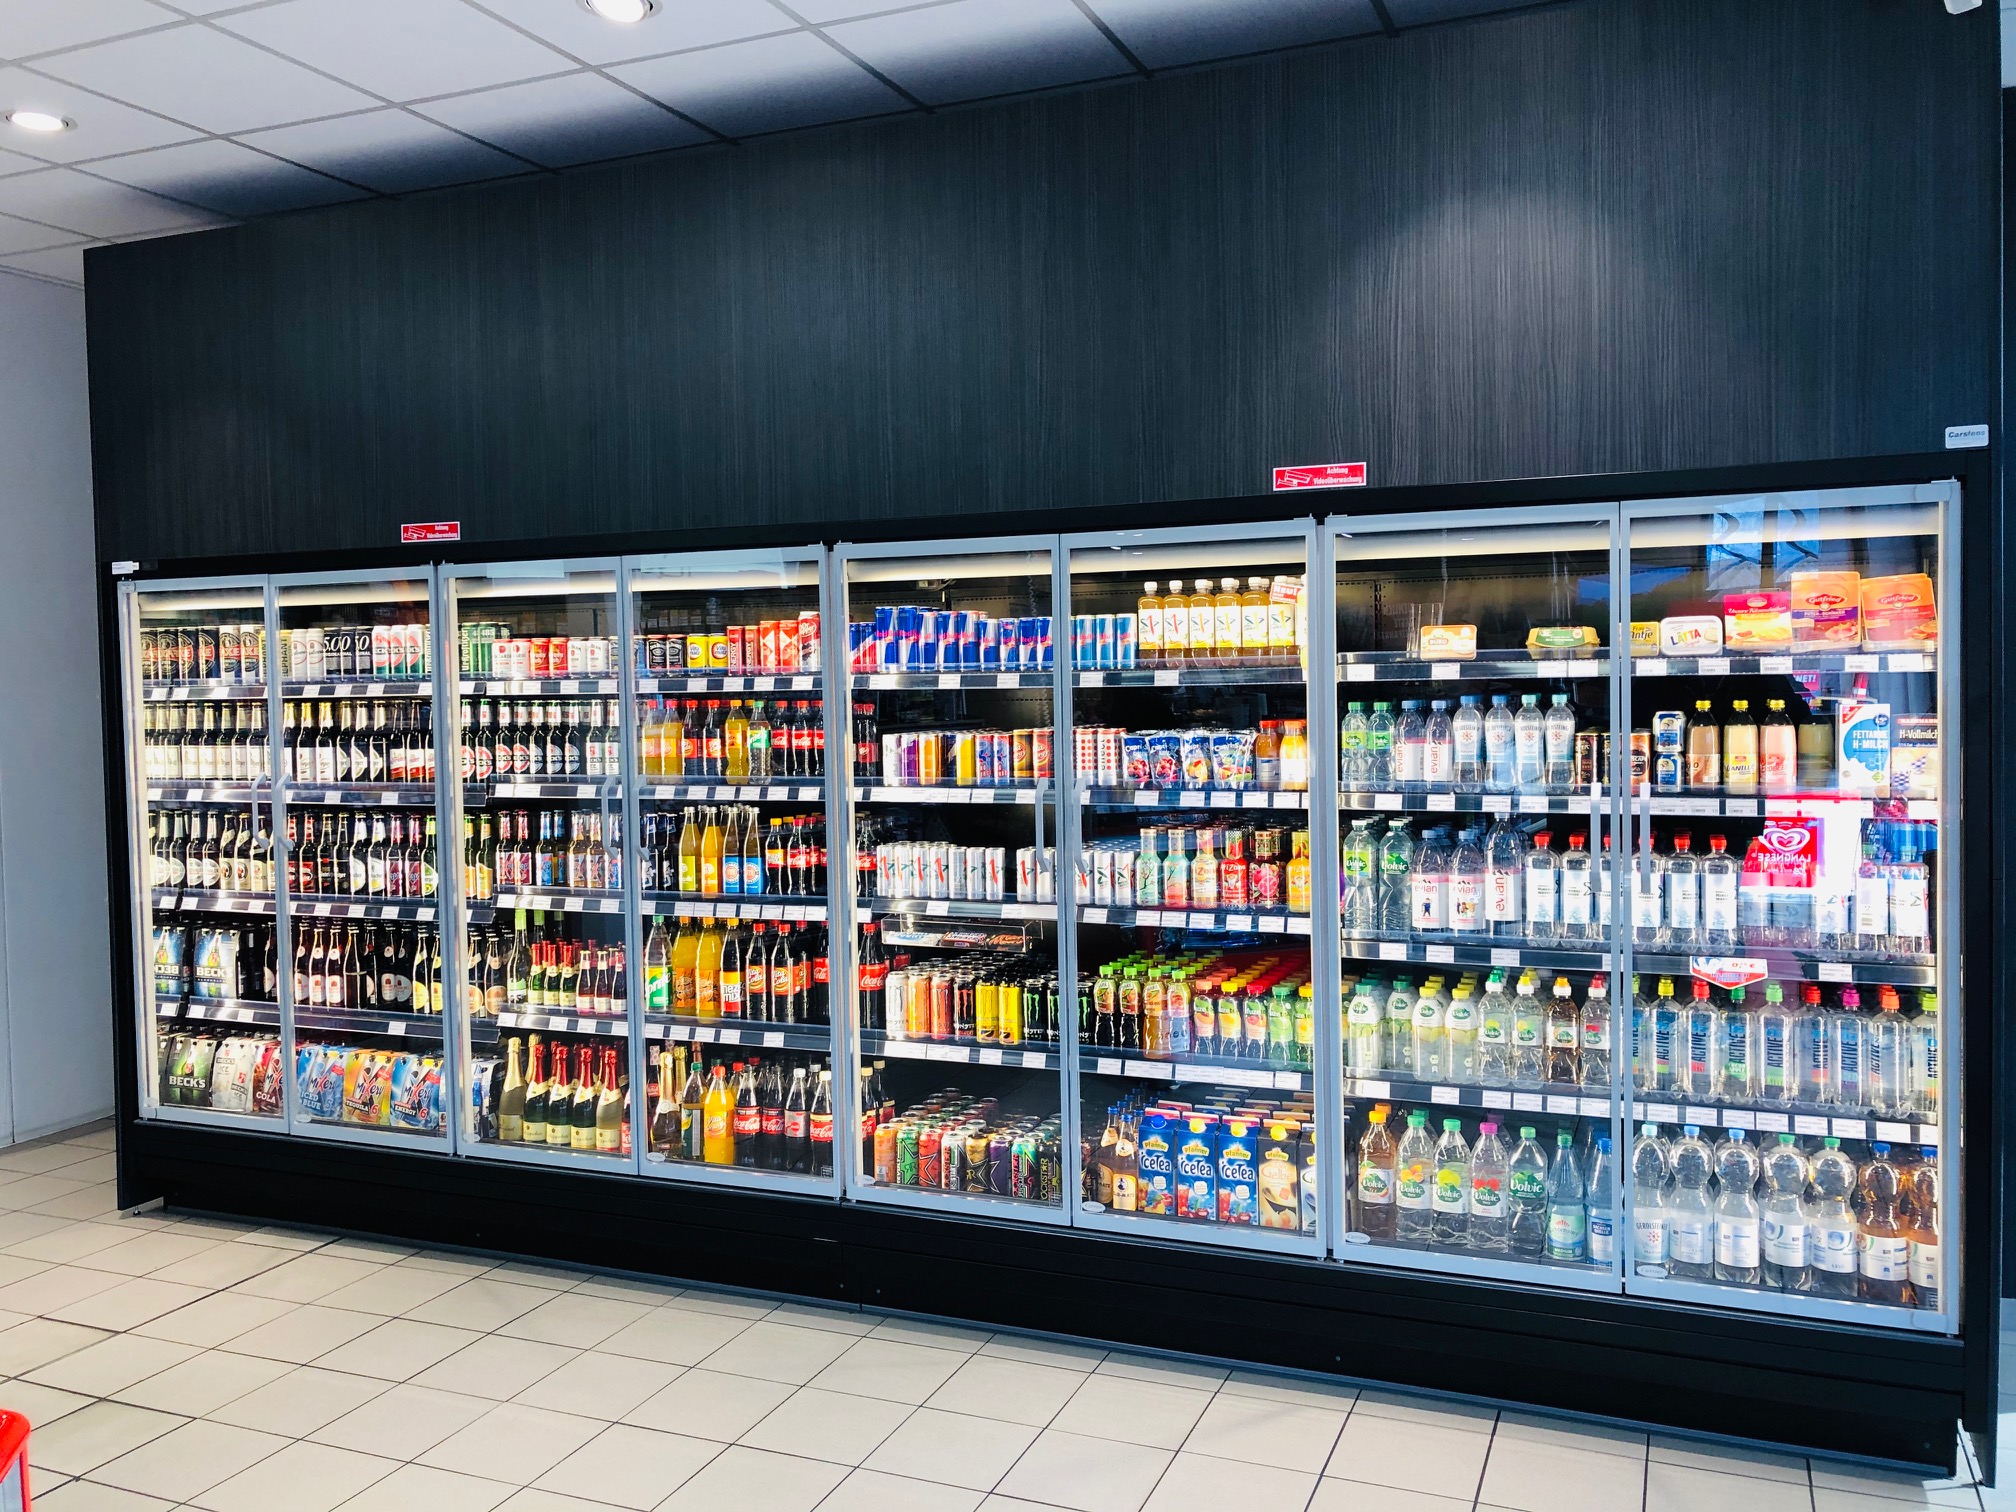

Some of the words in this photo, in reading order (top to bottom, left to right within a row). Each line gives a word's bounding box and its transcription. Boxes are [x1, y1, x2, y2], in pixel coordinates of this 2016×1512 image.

[1948, 430, 1986, 438] Carstens
[1326, 467, 1349, 475] Achtung
[1313, 476, 1362, 485] Videoüberwachung
[1809, 596, 1843, 604] Gutfried
[1670, 629, 1702, 646] LÄTTA
[1900, 729, 1938, 740] H-Vollmilch
[1495, 877, 1505, 912] evian
[1767, 1036, 1784, 1068] ACTIVE
[1841, 1040, 1858, 1073] ACTIVE
[168, 1076, 206, 1088] BECK'S
[256, 1091, 276, 1104] COLA
[370, 1104, 380, 1115] 6
[394, 1105, 417, 1116] ENERGY
[419, 1108, 428, 1119] 6
[1362, 1178, 1386, 1188] Volvic
[1400, 1183, 1424, 1193] Volvic
[1510, 1180, 1543, 1192] Volvic
[1437, 1186, 1460, 1197] Volvic
[1474, 1191, 1500, 1202] Volvic
